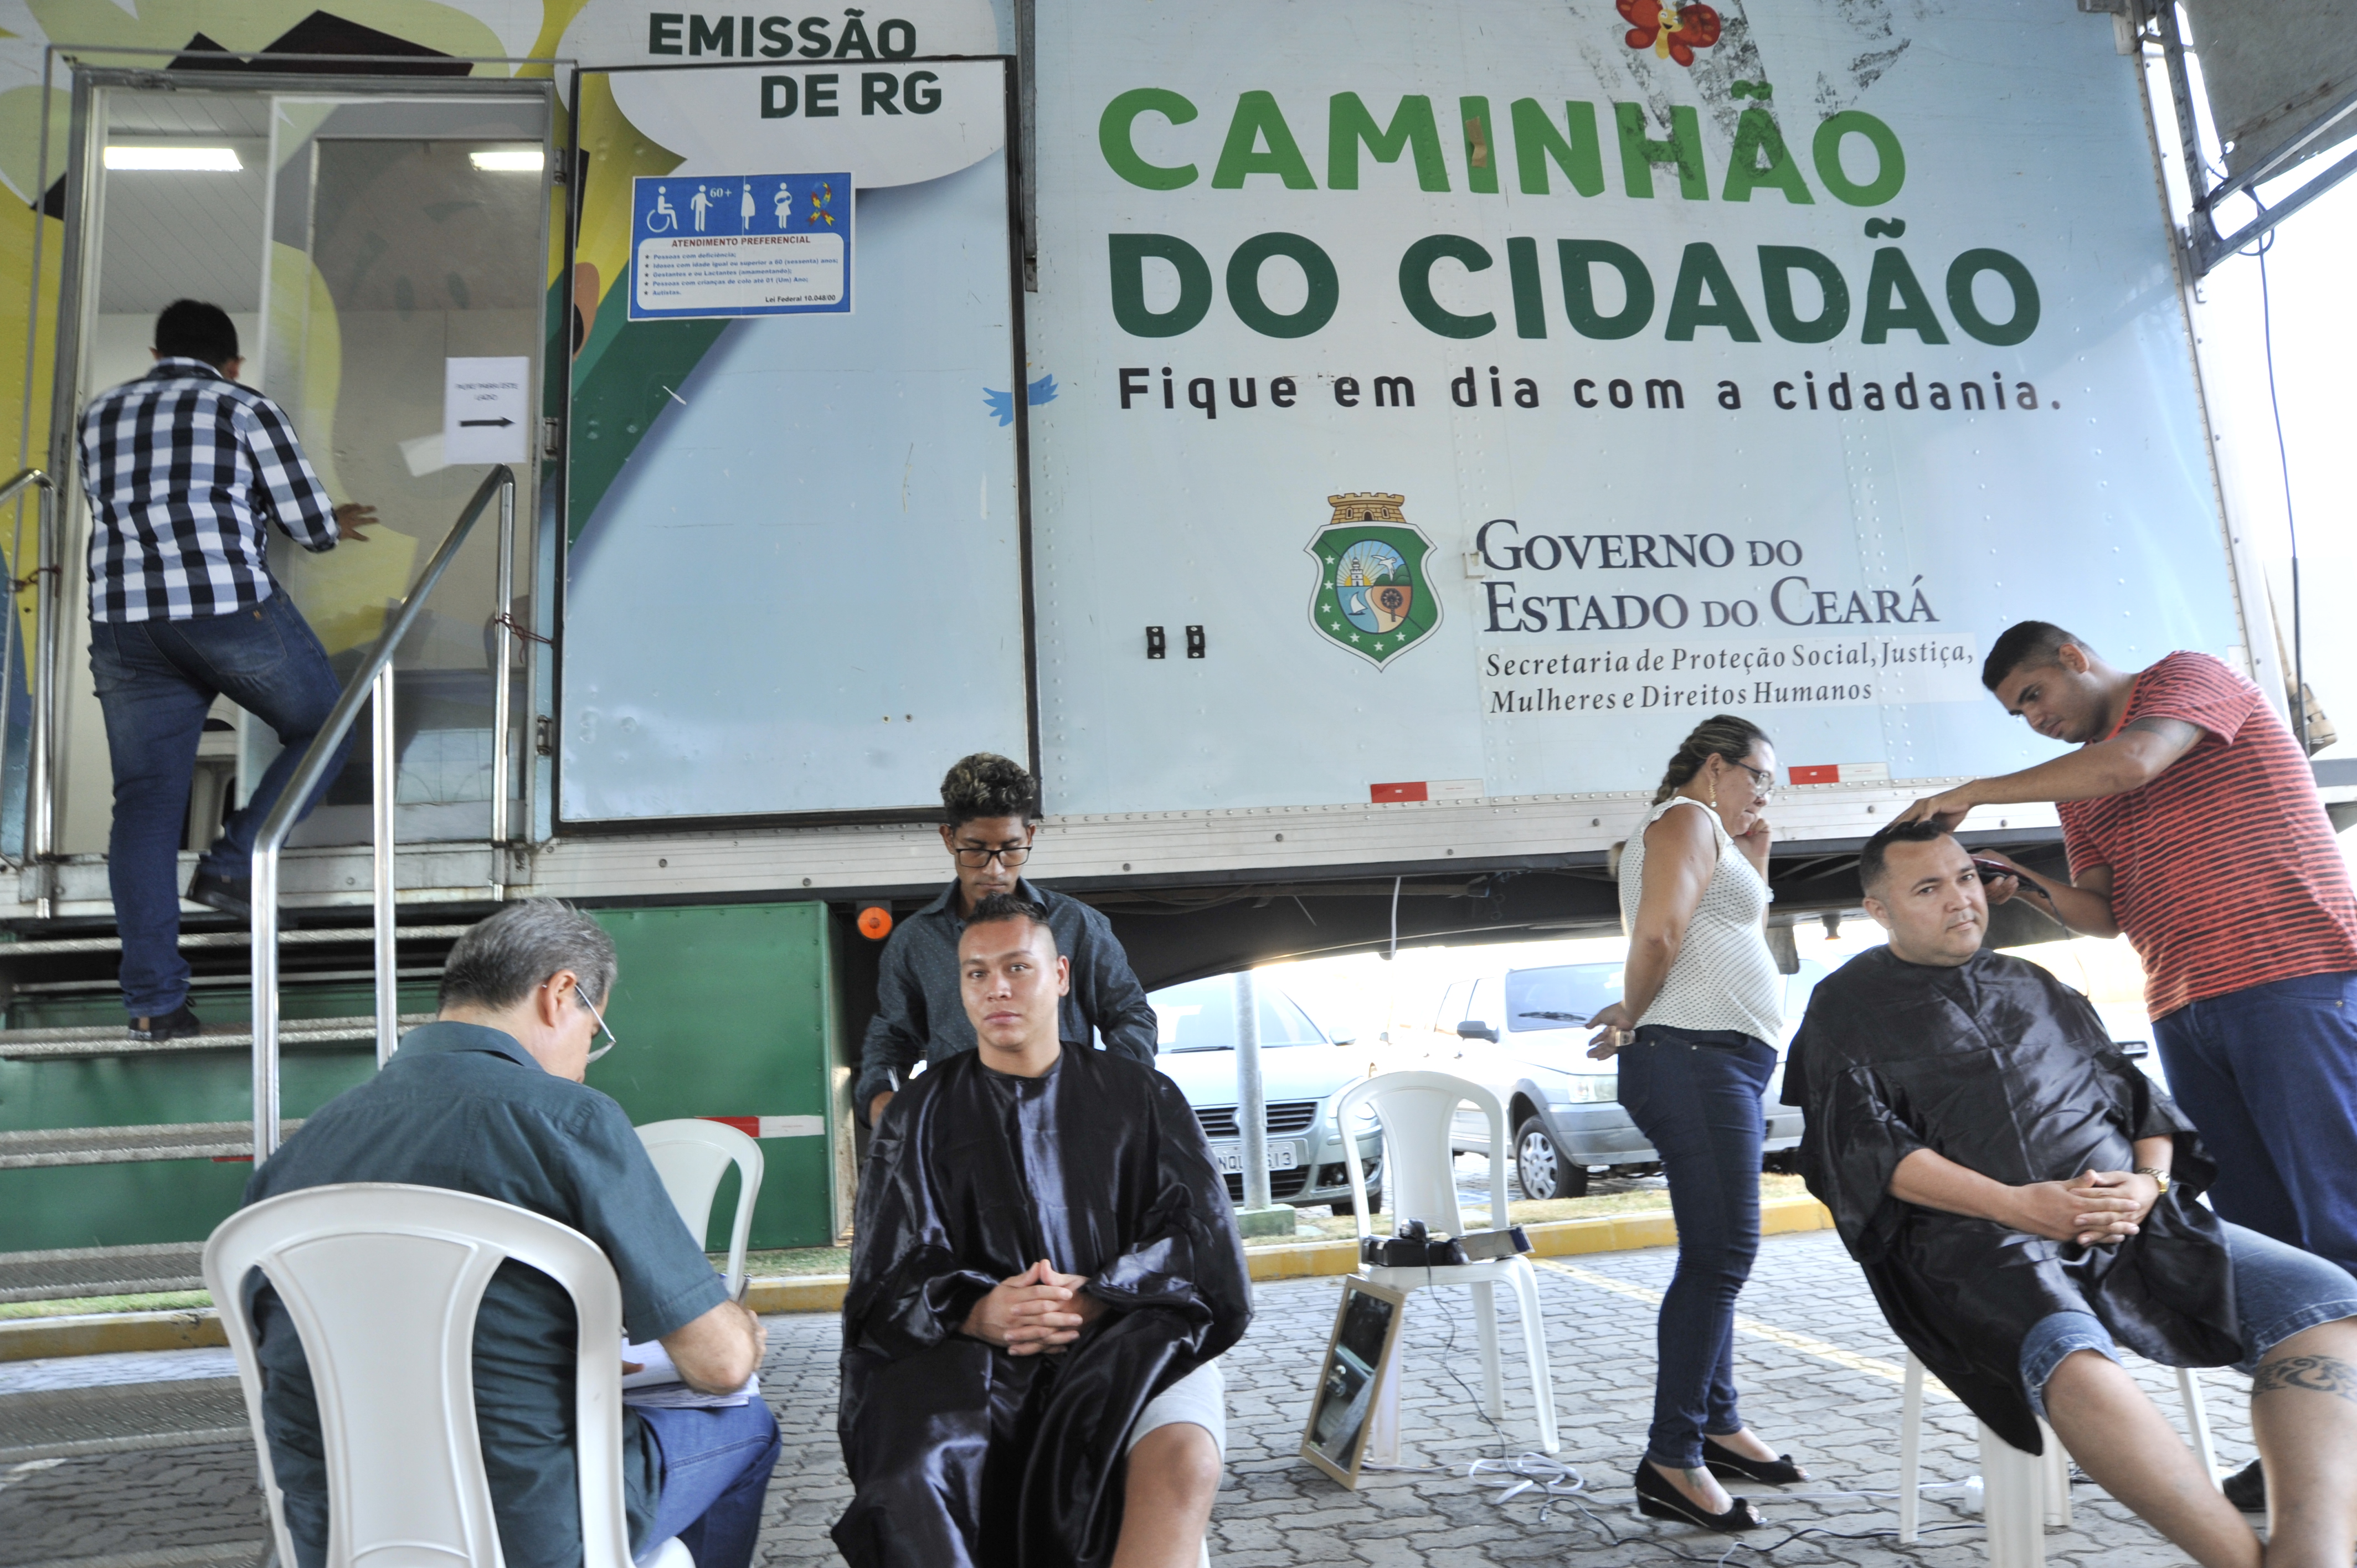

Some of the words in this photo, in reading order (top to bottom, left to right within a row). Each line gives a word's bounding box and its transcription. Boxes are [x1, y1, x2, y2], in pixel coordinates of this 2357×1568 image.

[649, 8, 917, 59] EMISSÃO
[761, 73, 839, 119] DE
[861, 70, 942, 116] RG
[1099, 80, 1906, 207] CAMINHÃO
[709, 187, 732, 198] 60+
[672, 238, 738, 247] ATENDIMENTO
[741, 236, 811, 245] PREFERENCIAL
[1108, 231, 1340, 339] DO
[1398, 218, 2040, 346] CIDADÃO
[1118, 366, 1298, 420] Fique
[1334, 375, 1416, 409] em
[1452, 365, 1540, 409] dia
[1573, 378, 1685, 409] com
[1717, 379, 1742, 410] a
[1773, 370, 2061, 411] cidadania.
[1476, 519, 1736, 571] GOVERNO
[1749, 540, 1803, 566] DO
[1480, 581, 1689, 632] ESTADO
[1701, 600, 1759, 628] DO
[1772, 575, 1941, 626] CEARÁ
[1486, 651, 1630, 677] Secretaria
[1636, 648, 1665, 672] de
[1671, 647, 1786, 674] Proteção
[1792, 642, 1877, 667] Social,
[1881, 641, 1974, 668] Justiça,
[1490, 687, 1617, 714] Mulheres
[1623, 692, 1635, 708] e
[1640, 684, 1747, 708] Direitos
[1753, 681, 1872, 704] Humanos
